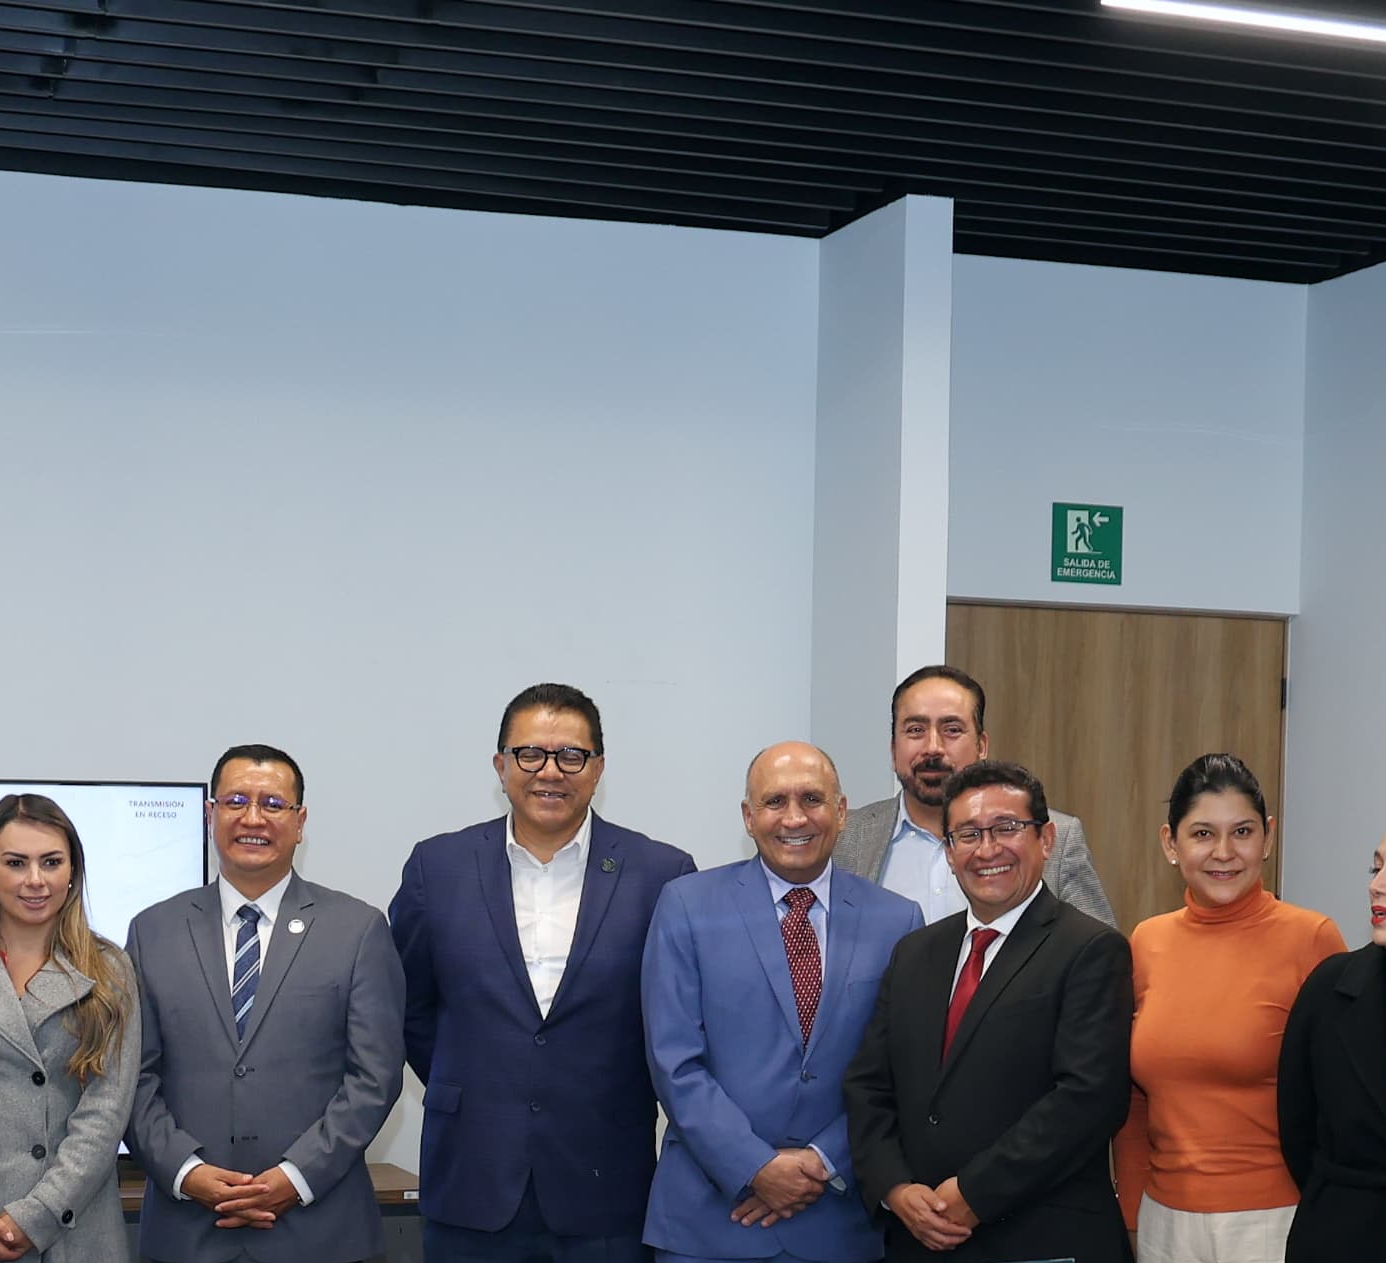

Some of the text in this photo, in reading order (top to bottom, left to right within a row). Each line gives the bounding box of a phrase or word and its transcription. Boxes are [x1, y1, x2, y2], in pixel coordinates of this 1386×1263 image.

[1063, 558, 1110, 568] SALIDA DE
[1057, 567, 1116, 579] EMERGENCIA
